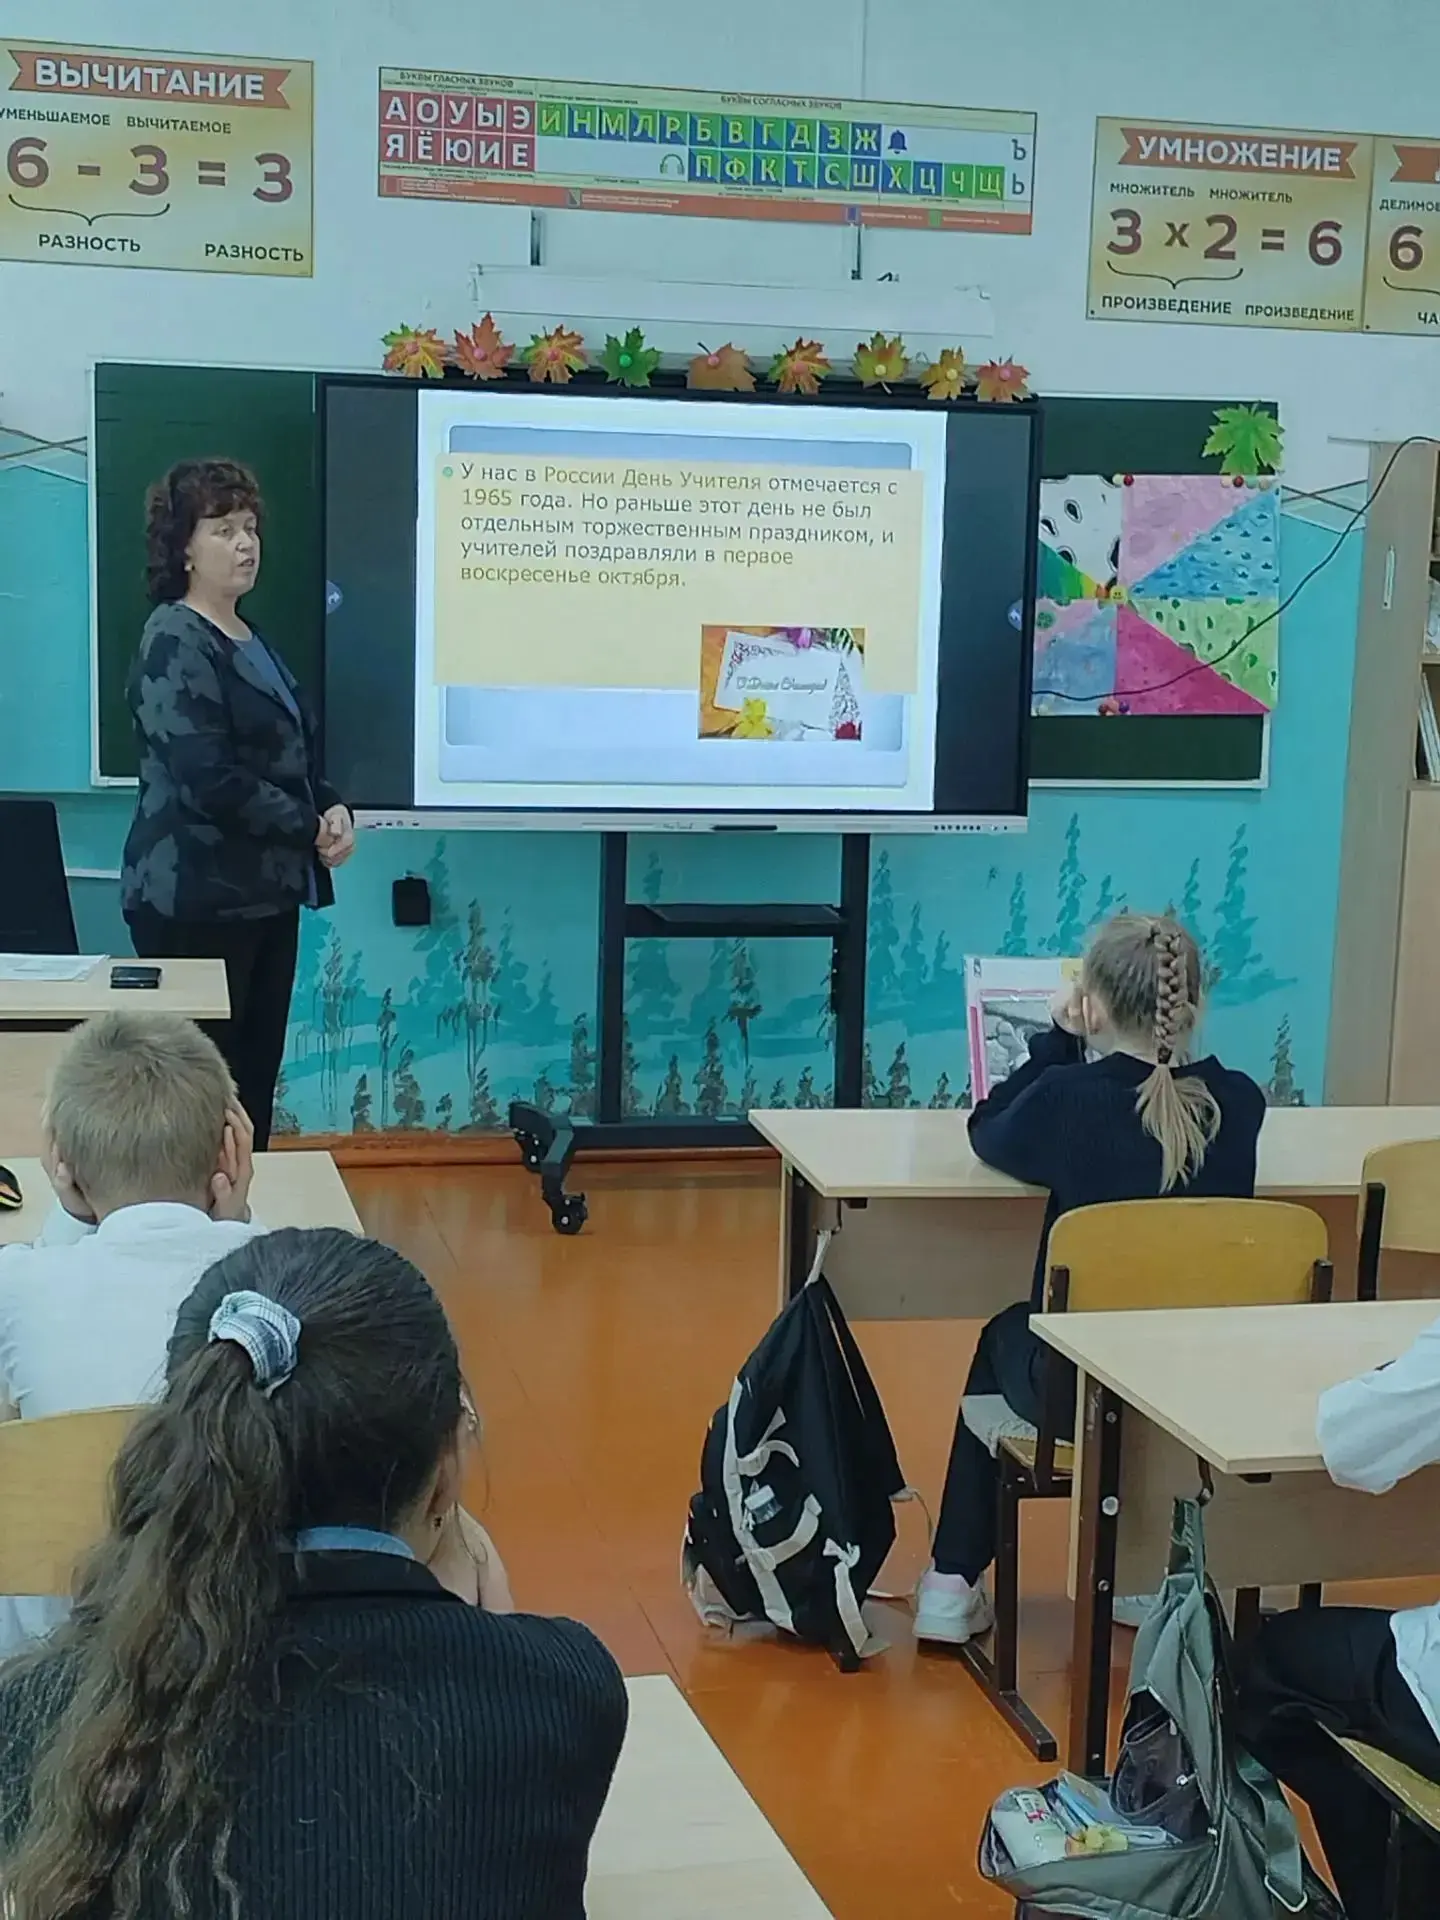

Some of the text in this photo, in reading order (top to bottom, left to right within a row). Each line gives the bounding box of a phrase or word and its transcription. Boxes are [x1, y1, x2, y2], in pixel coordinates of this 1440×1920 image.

[35, 59, 264, 100] ВЫЧИТАНИЕ
[0, 108, 231, 134] УМЕНЬШАЕМОЕ ВЫЧИТАЕМОЕ
[1137, 135, 1342, 171] УМНОЖЕНИЕ
[7, 137, 49, 188] 6
[129, 144, 169, 195] 3
[253, 152, 293, 203] 3
[1110, 183, 1293, 203] МНОЖИТЕЛЬ МНОЖИТЕЛЬ
[38, 233, 141, 252] РАЗНОСТЬ
[1107, 208, 1142, 255] 3
[1204, 215, 1237, 260] 2
[1308, 221, 1342, 265] 6
[1390, 225, 1423, 271] 6
[205, 244, 304, 261] РАЗНОСТЬ
[1102, 295, 1232, 315] ПРОИЗВЕДЕНИЕ
[1245, 305, 1354, 321] ПРОИЗВЕДЕНИЕ
[1418, 312, 1440, 325] ЧА
[461, 462, 897, 495] У нас в России День Учителя отмечается с
[463, 489, 871, 519] 1965 года. Но раньше этот день не был
[461, 516, 894, 546] отдельным торжественным праздником, и
[461, 541, 793, 567] учителей поздравляли в первое
[461, 567, 686, 590] воскресенье октября.
